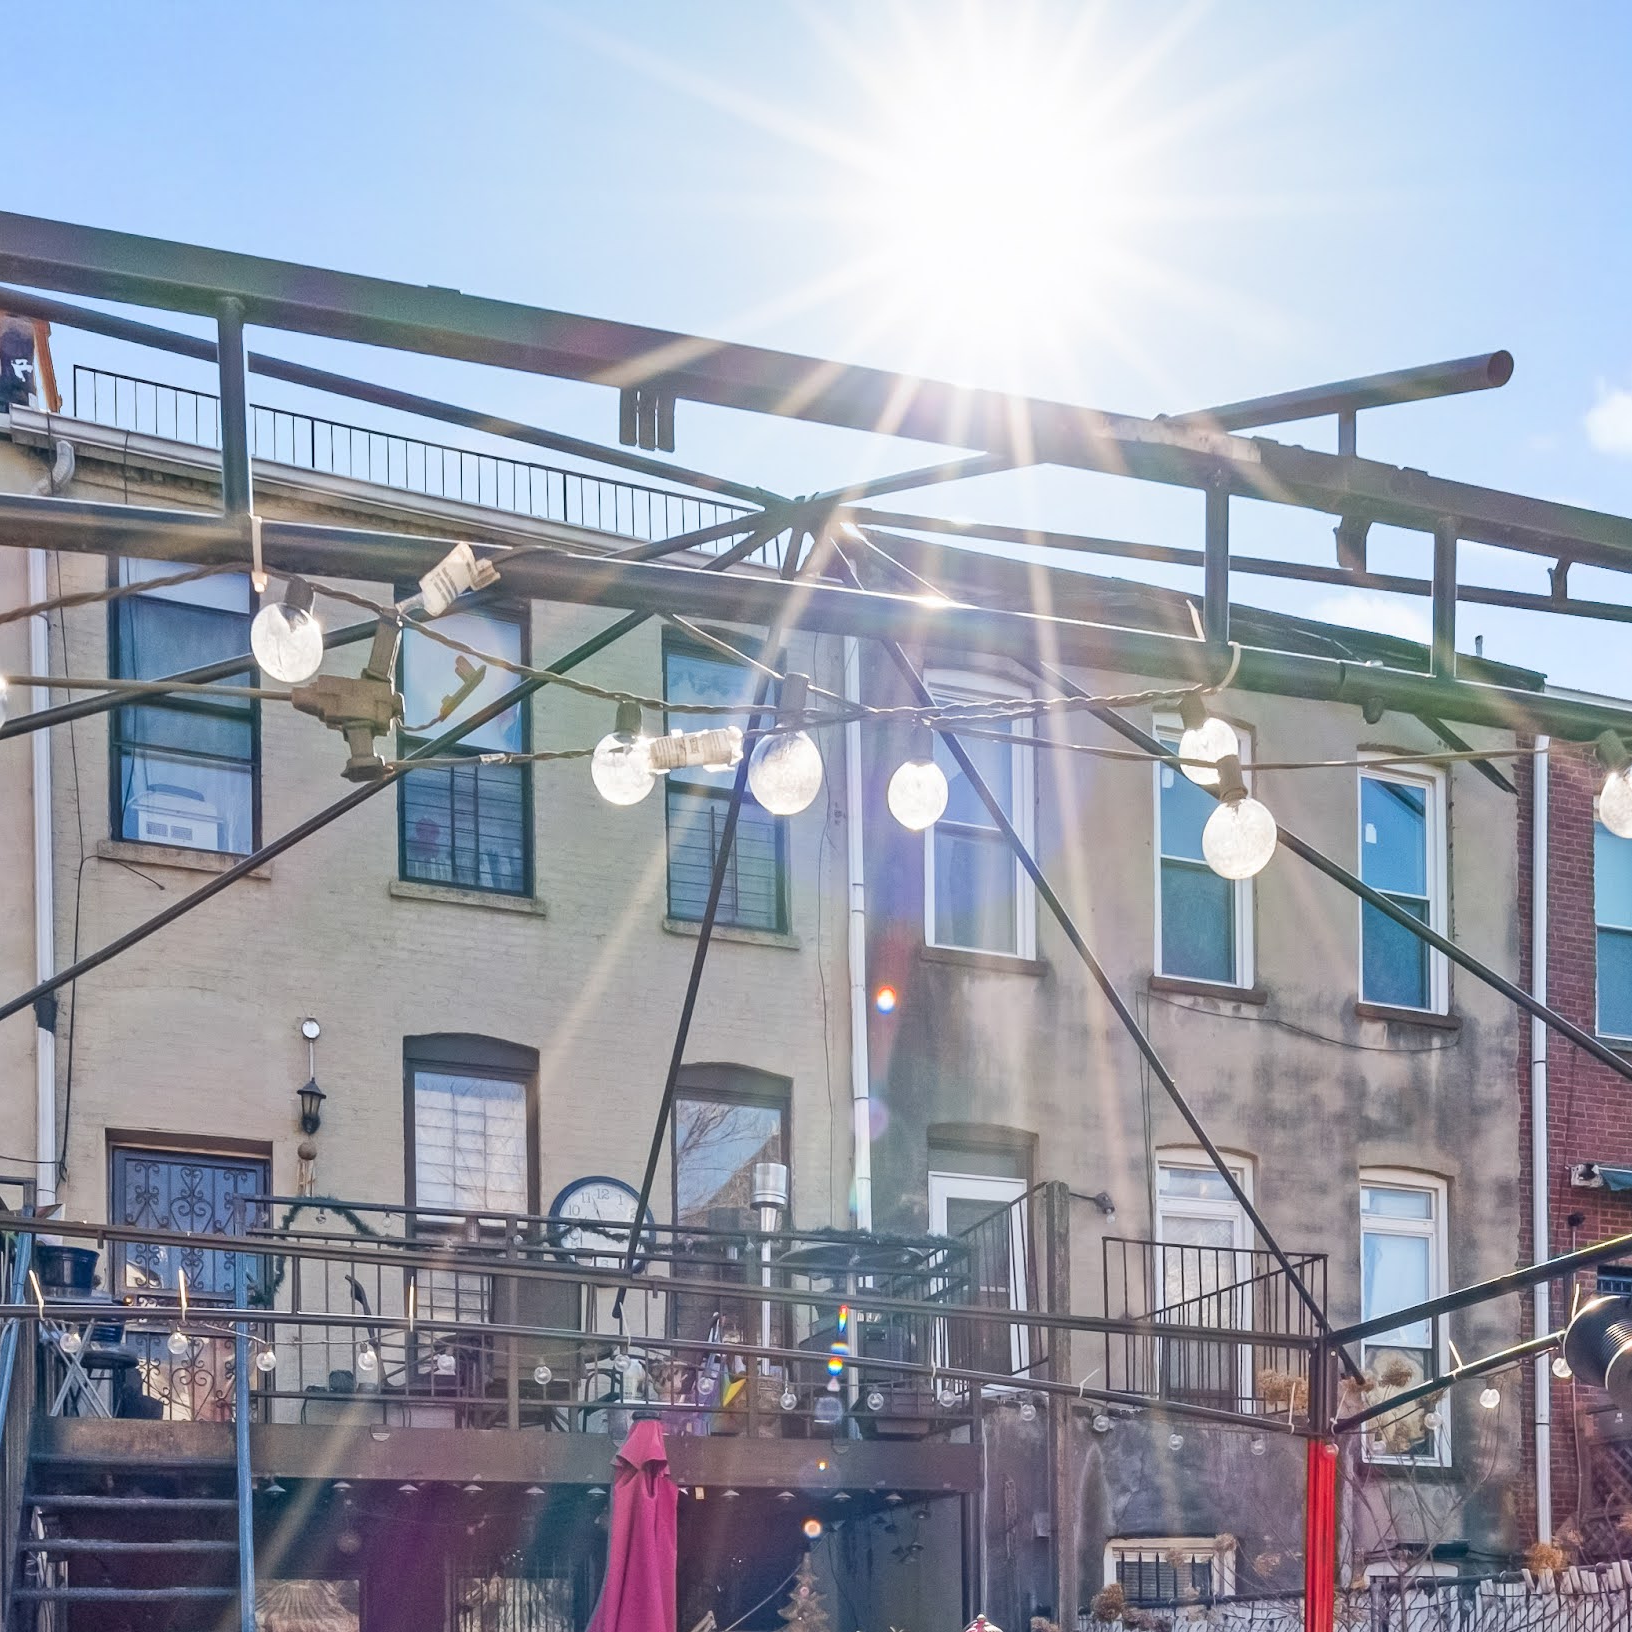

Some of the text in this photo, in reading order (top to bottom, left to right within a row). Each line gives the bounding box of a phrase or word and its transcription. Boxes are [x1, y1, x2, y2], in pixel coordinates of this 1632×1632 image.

[581, 1192, 591, 1204] 11
[597, 1188, 610, 1200] 12
[618, 1194, 624, 1205] 1
[568, 1204, 581, 1216] 10
